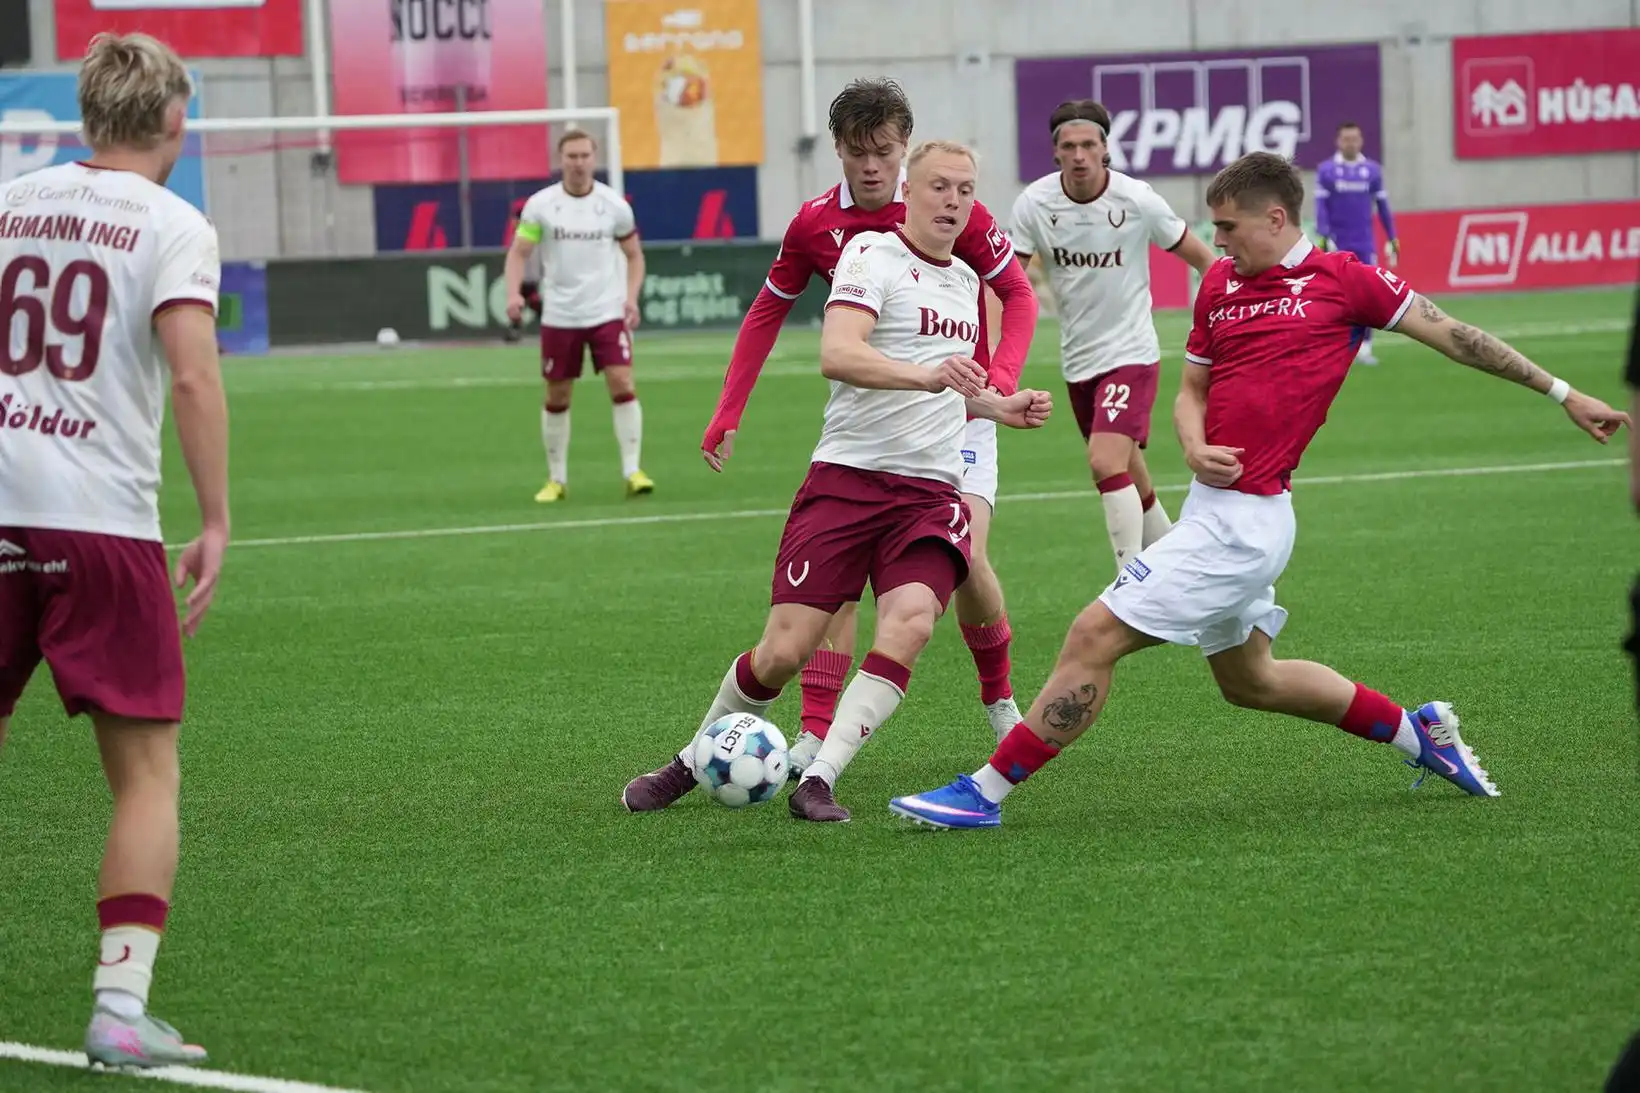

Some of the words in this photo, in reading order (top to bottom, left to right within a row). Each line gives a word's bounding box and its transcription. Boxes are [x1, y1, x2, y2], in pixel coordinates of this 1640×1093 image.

[1538, 78, 1640, 125] HÚSA
[1107, 101, 1302, 171] KPMG
[0, 210, 86, 241] ÁRMANN
[87, 221, 140, 252] INGI
[1527, 231, 1603, 263] ALLA
[1051, 246, 1124, 268] Boozt
[0, 254, 110, 382] 69
[1102, 384, 1130, 409] 22
[720, 716, 757, 755] SELECT
